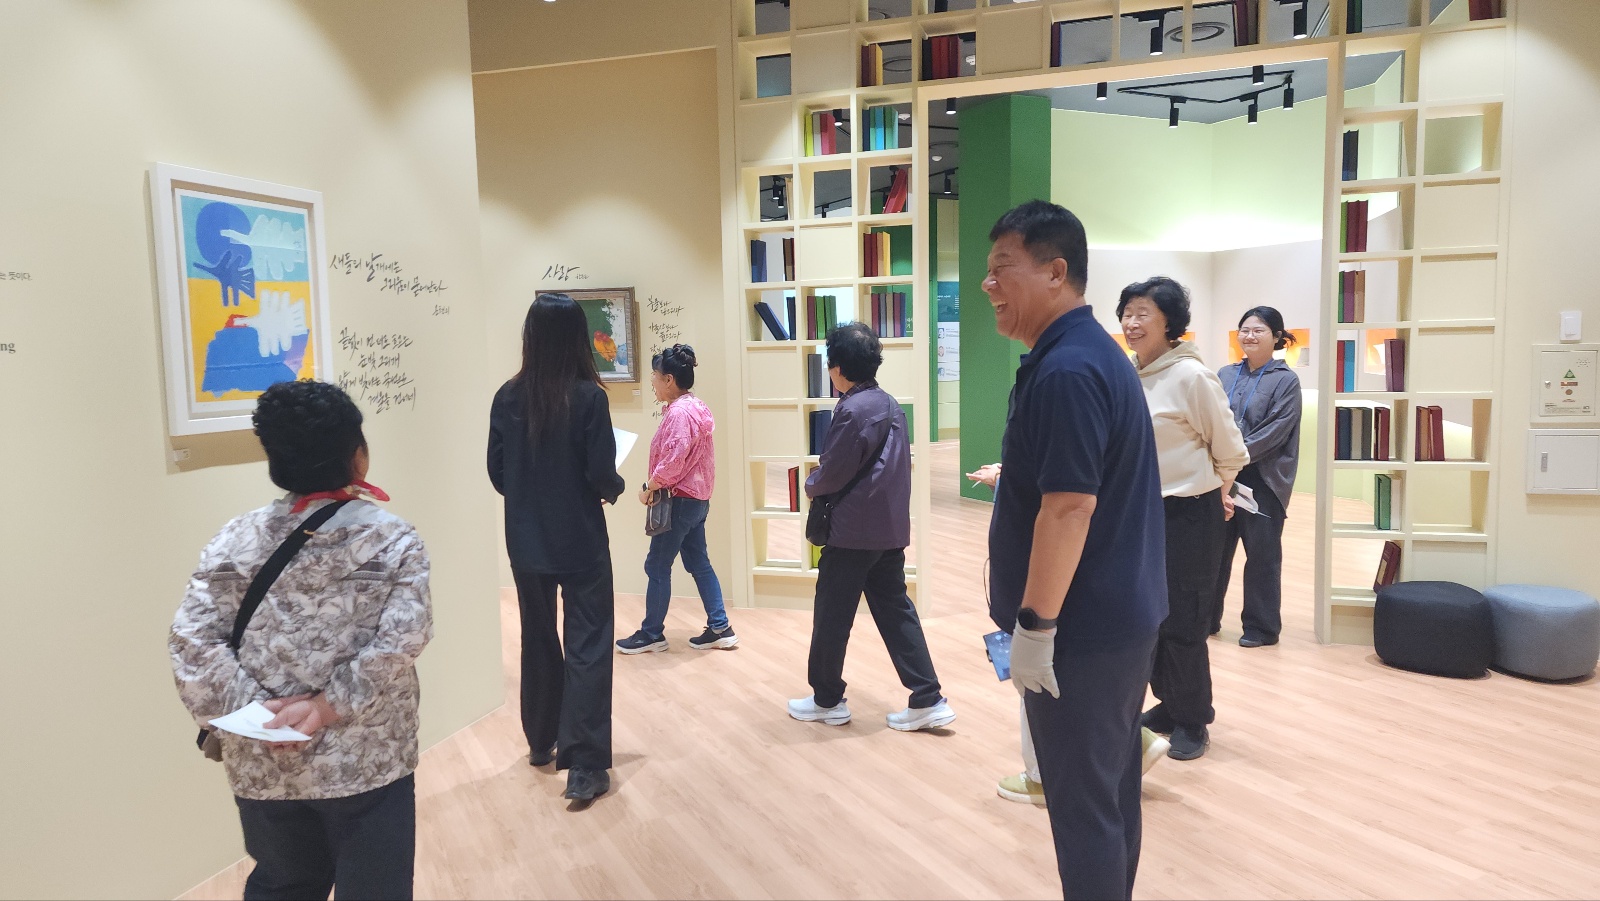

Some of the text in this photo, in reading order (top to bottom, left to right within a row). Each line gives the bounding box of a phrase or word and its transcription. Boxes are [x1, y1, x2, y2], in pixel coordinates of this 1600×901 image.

[330, 252, 402, 282] 새들의 날개에는
[542, 264, 580, 281] 사랑
[380, 276, 410, 295] 그리움이
